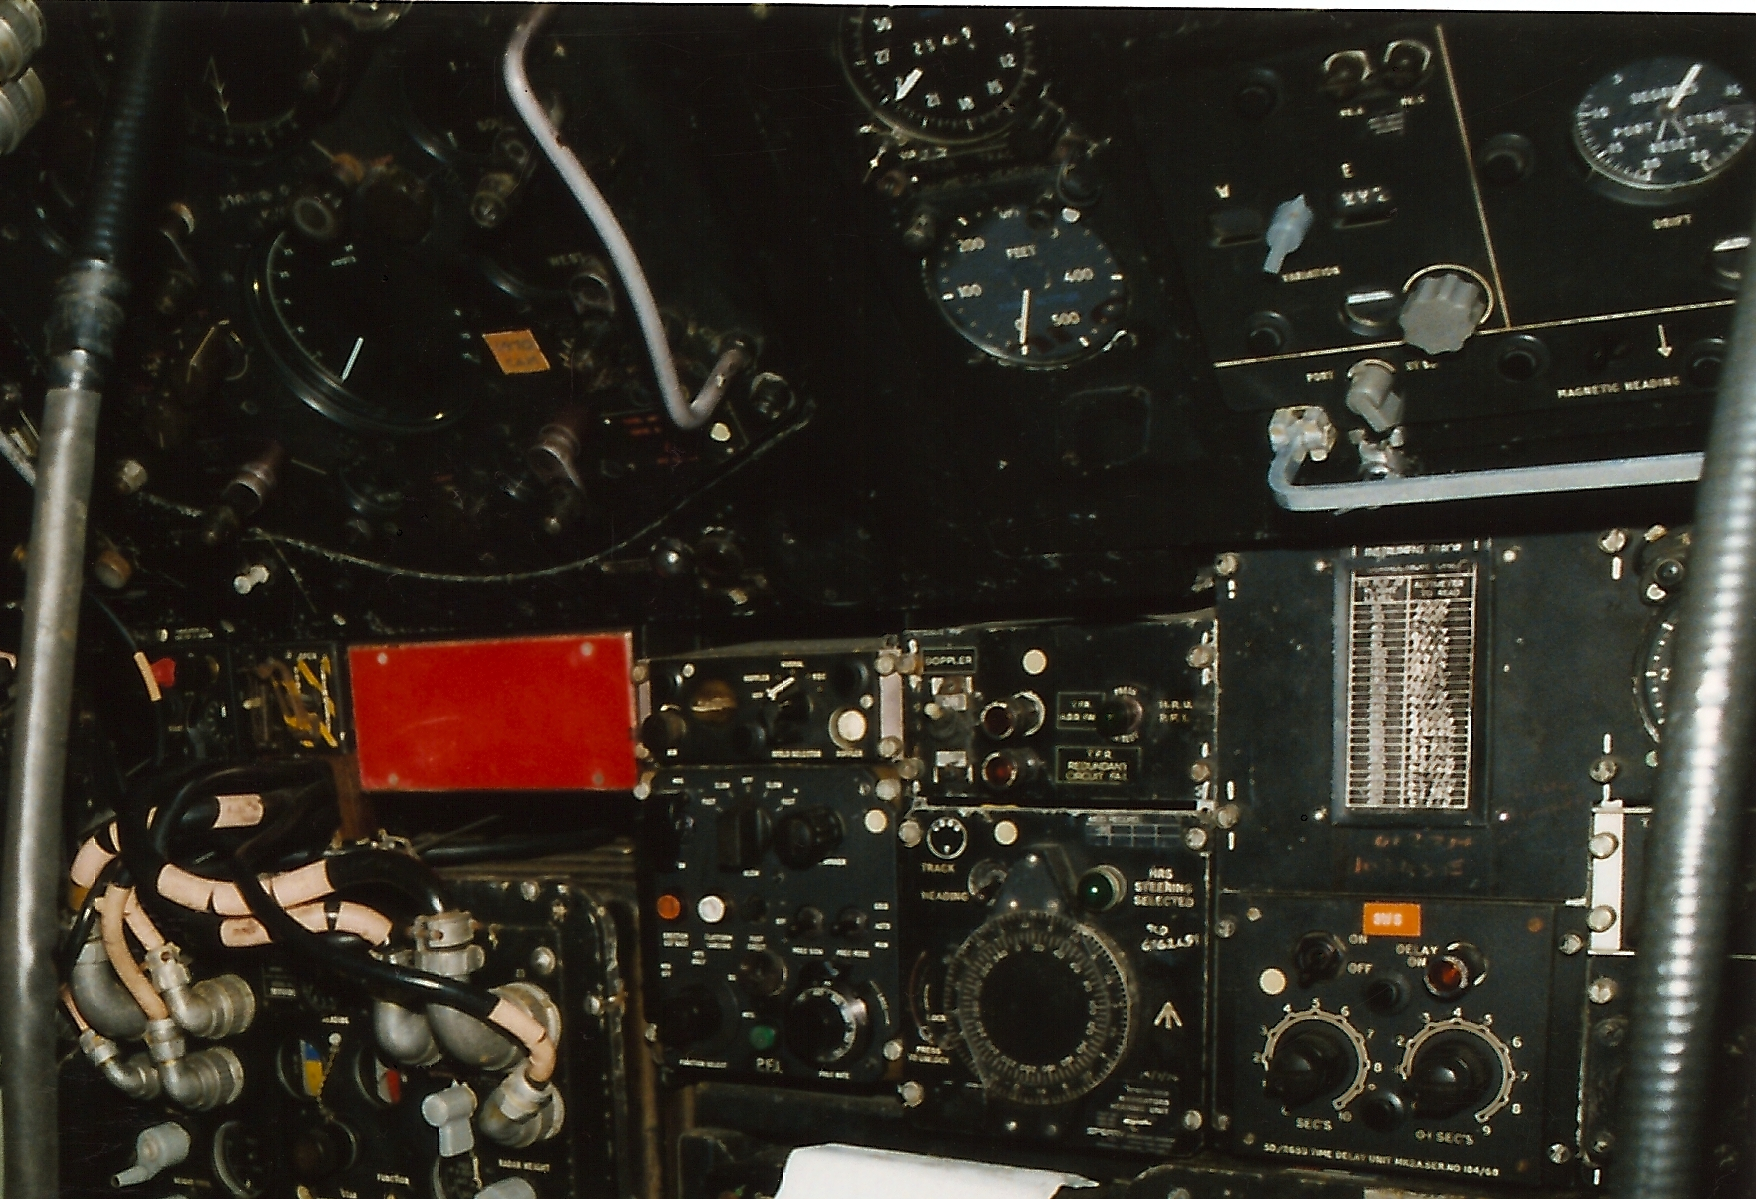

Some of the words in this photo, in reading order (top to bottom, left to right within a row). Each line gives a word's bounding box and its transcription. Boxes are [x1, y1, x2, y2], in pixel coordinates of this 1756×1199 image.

[924, 654, 973, 666] DOPPLER
[920, 862, 956, 874] TRACK
[1133, 880, 1194, 895] STEERING
[920, 890, 970, 902] HEADING
[1133, 895, 1195, 908] SELECTED
[1348, 932, 1369, 945] ON
[1395, 943, 1439, 956] DELAY
[1406, 955, 1428, 968] ON
[1347, 962, 1374, 975] OFF
[1452, 1006, 1463, 1018] 4
[1512, 1035, 1523, 1049] 6
[1373, 1061, 1384, 1074] 8
[1511, 1103, 1522, 1116] 8
[1310, 1147, 1333, 1160] TIME
[1334, 1150, 1368, 1163] DELAY
[1368, 1153, 1393, 1166] UNIT
